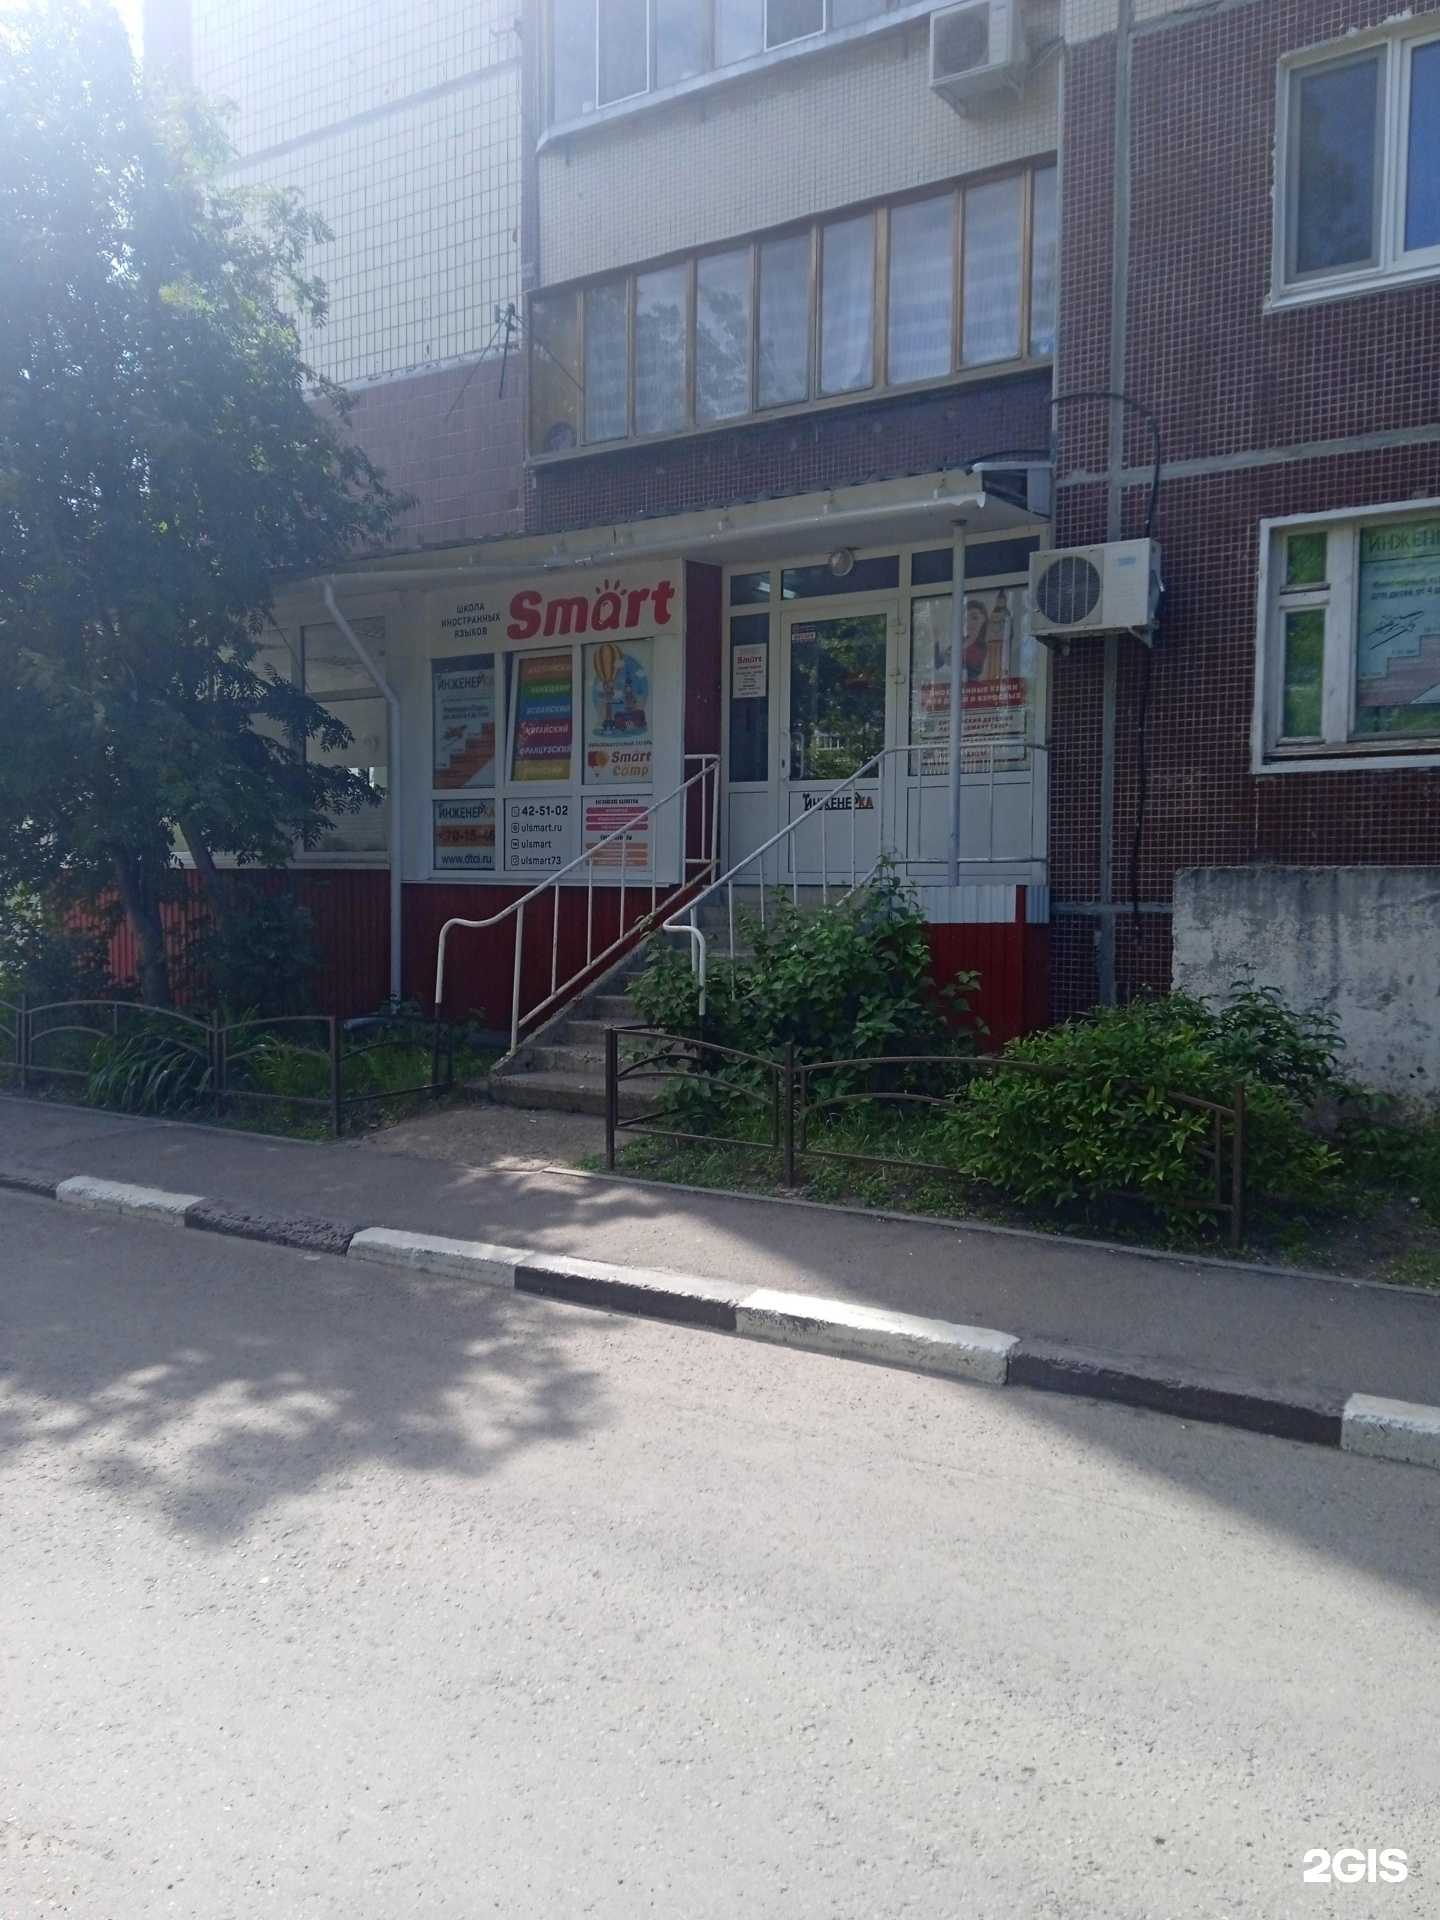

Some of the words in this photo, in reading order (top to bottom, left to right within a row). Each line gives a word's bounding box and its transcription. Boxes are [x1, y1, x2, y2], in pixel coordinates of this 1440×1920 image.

[456, 603, 485, 614] ШКОЛА
[507, 580, 675, 640] Smart
[441, 613, 501, 628] ИНОСТРАННЫХ
[454, 626, 488, 639] ЯЗЫКОВ
[611, 751, 652, 764] Smart
[521, 805, 568, 817] 42-51-02
[521, 823, 562, 833] ulsmart.ru
[521, 839, 552, 849] ulsmart
[521, 855, 561, 865] ulsmart73
